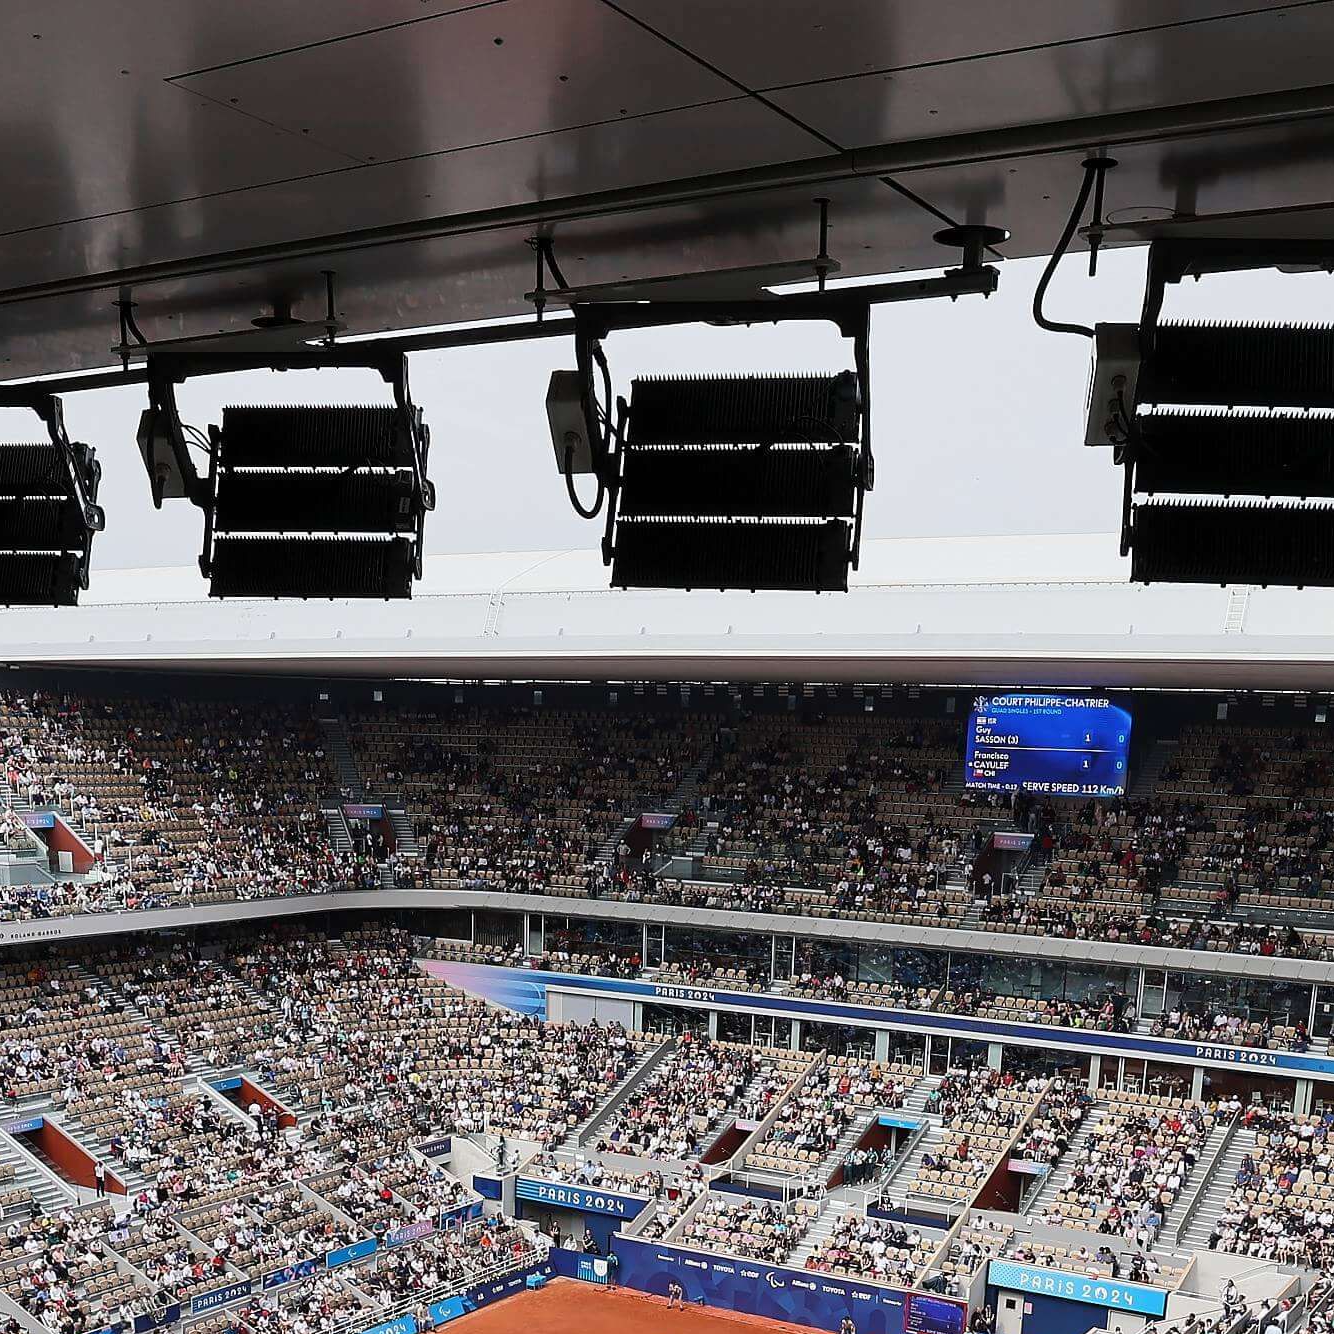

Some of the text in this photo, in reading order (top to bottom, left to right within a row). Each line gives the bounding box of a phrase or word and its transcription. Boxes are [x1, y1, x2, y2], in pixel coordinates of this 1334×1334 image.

[991, 697, 1109, 708] COURT PHILIPPE-CHATRIER
[975, 725, 992, 735] Guy
[975, 735, 1006, 744] SASSON
[1084, 733, 1091, 742] 1
[1118, 734, 1125, 743] 0
[974, 750, 1009, 760] Francisco
[973, 760, 1010, 769] CAYULEF
[1082, 760, 1089, 768] 1
[1116, 761, 1123, 769] 0
[965, 781, 987, 789] MATCH
[1051, 783, 1080, 793] SPEED
[1081, 784, 1099, 794] 112
[1099, 785, 1125, 795] Km/h
[655, 986, 715, 1001] PARIS 2024
[1196, 1046, 1276, 1065] PARIS 2024
[539, 1186, 624, 1213] PARIS 2024
[713, 1264, 735, 1274] TOYOTA
[822, 1285, 846, 1295] TOYOTA
[197, 1285, 247, 1309] PARIS 2024
[1083, 1284, 1134, 1306] 2024
